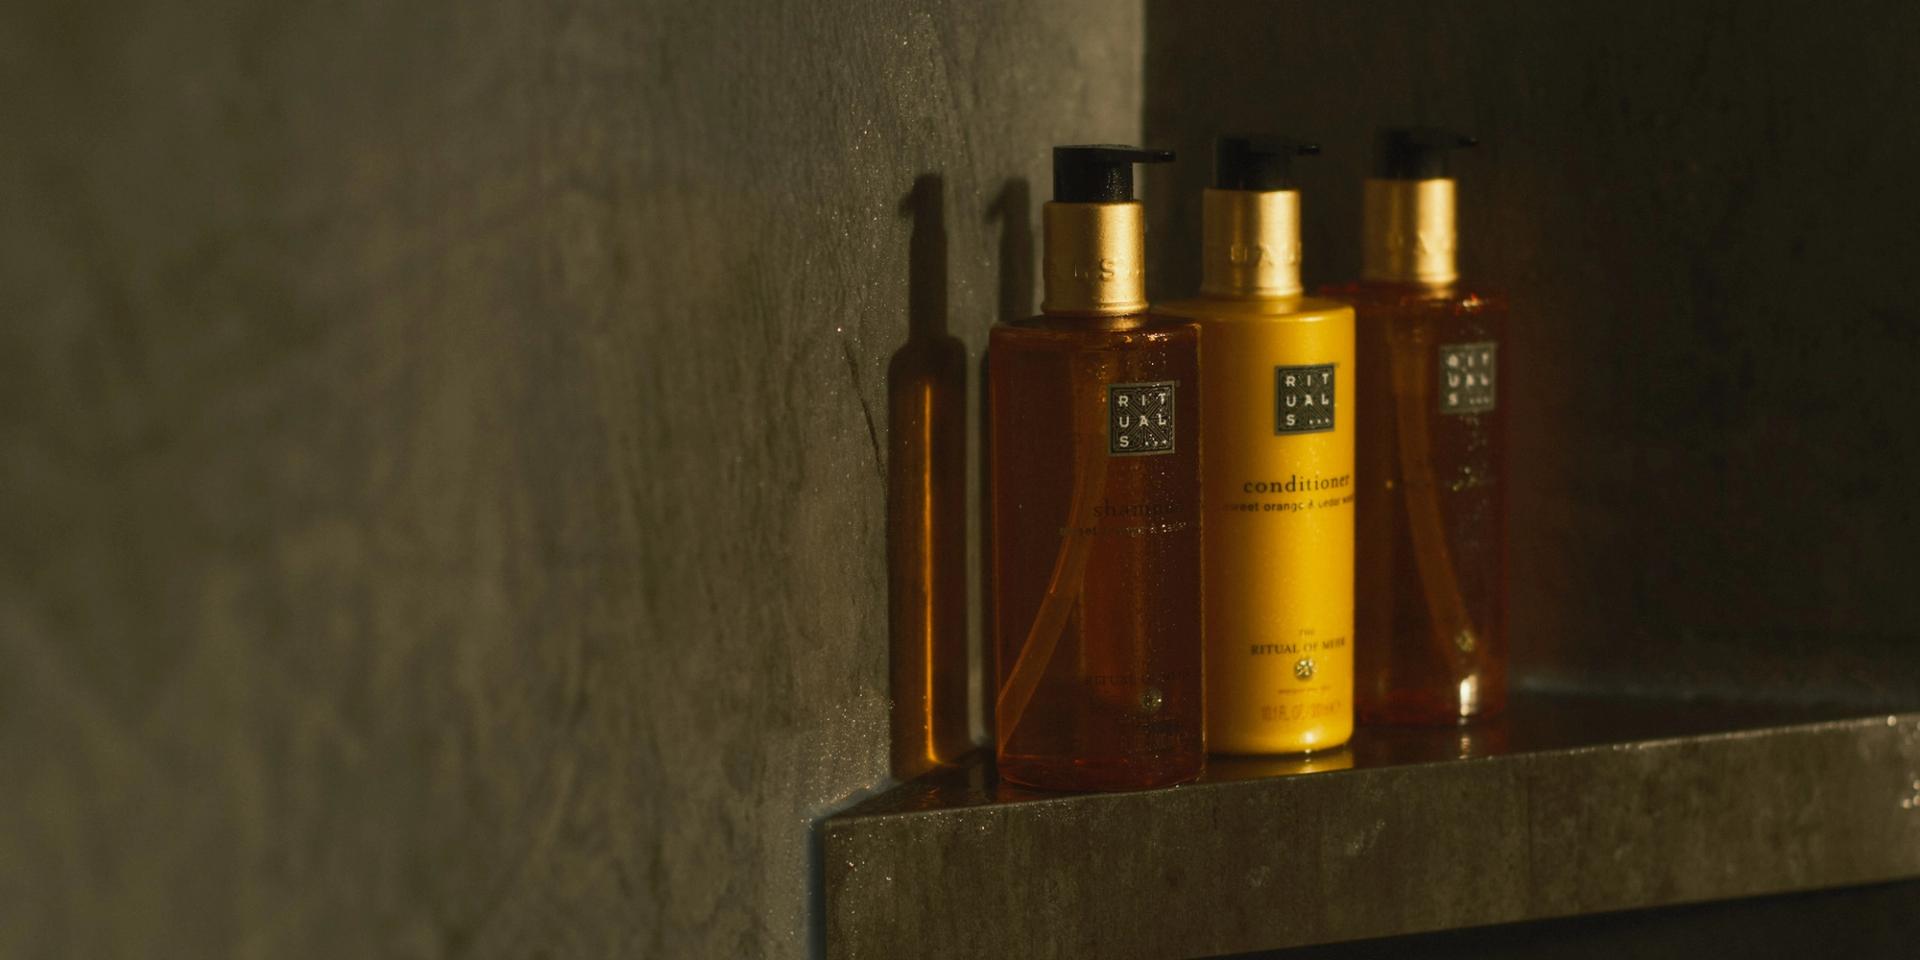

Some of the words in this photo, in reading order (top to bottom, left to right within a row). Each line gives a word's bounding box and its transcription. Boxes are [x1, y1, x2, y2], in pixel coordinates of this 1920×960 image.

[1284, 373, 1329, 387] RIT
[1118, 393, 1167, 407] RIT
[1286, 393, 1329, 407] UAL
[1119, 413, 1167, 428] UAL
[1243, 474, 1350, 494] conditioner
[1263, 502, 1304, 513] orange
[1251, 643, 1299, 656] RITUAL
